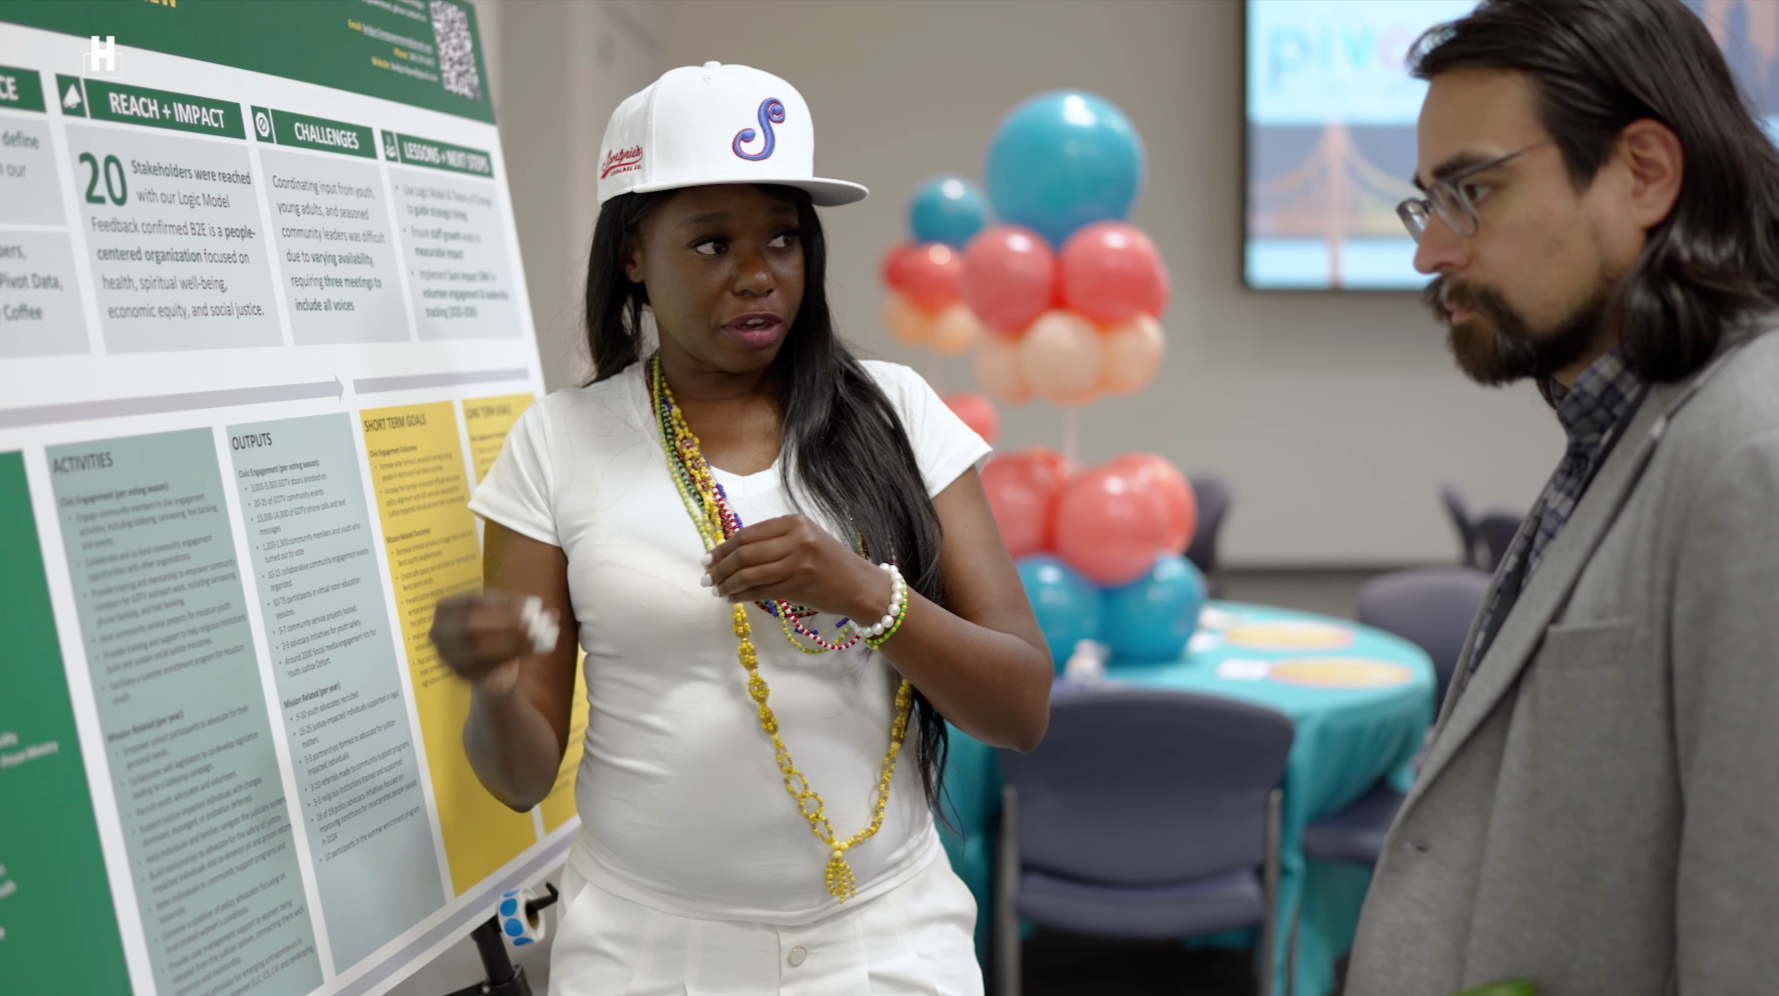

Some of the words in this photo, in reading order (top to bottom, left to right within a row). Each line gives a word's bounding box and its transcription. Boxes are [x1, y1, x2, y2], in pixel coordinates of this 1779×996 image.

[1265, 24, 1412, 97] pivo
[108, 92, 160, 119] REACH
[162, 104, 171, 119] +
[173, 102, 224, 128] IMPACT
[294, 122, 359, 150] CHALLENGES
[732, 97, 785, 161] S
[2, 129, 39, 150] define
[404, 141, 440, 164] LESSONS
[446, 150, 468, 169] NEXT
[467, 155, 490, 173] STEPS
[6, 163, 26, 178] our
[78, 152, 128, 206] 20
[131, 160, 193, 179] Stakeholders
[194, 170, 216, 181] were
[218, 170, 251, 184] reached
[272, 175, 319, 194] Coordinating
[319, 180, 338, 195] input
[338, 182, 354, 195] from
[355, 187, 375, 200] youth,
[136, 188, 158, 202] with
[160, 193, 176, 204] our
[178, 191, 201, 208] Logic
[202, 193, 230, 208] Model
[277, 203, 301, 216] young
[301, 202, 325, 217] adults,
[326, 205, 338, 217] and
[339, 208, 369, 220] seasoned
[91, 216, 139, 233] Feedback
[141, 219, 188, 235] confirmed
[190, 222, 207, 236] B2E
[208, 223, 216, 237] is
[217, 227, 223, 237] a
[224, 225, 256, 241] people-
[282, 227, 322, 241] community
[322, 227, 347, 241] leaders
[348, 232, 361, 242] was
[362, 230, 385, 243] difficult
[97, 246, 142, 261] centered
[144, 248, 202, 264] organization
[204, 248, 237, 264] focused
[239, 254, 250, 264] on
[286, 249, 301, 262] due
[301, 251, 310, 262] to
[311, 251, 338, 266] varying
[338, 252, 375, 267] availability,
[31, 271, 64, 292] Data,
[102, 274, 138, 292] health,
[139, 275, 178, 292] spiritual
[179, 276, 228, 292] well-being,
[291, 274, 324, 289] requiring
[324, 274, 343, 287] three
[344, 276, 374, 290] meetings
[374, 278, 382, 288] to
[3, 302, 43, 321] Coffee
[108, 303, 156, 319] economic
[158, 303, 190, 320] equity,
[192, 302, 208, 316] and
[210, 302, 234, 316] social
[235, 302, 264, 318] justice.
[295, 298, 322, 310] include
[323, 298, 332, 310] all
[333, 299, 354, 310] voices
[364, 418, 386, 432] SHORT
[387, 416, 406, 429] TERM
[406, 413, 426, 426] GOALS
[232, 432, 272, 450] OUTPUTS
[53, 452, 113, 474] ACTIVITIES
[238, 470, 250, 478] Civic
[250, 466, 278, 477] Engagement
[279, 464, 288, 473] (per
[302, 459, 320, 468] season):
[284, 698, 302, 708] Mission
[302, 689, 319, 702] Related
[319, 688, 328, 697] (per
[328, 682, 341, 693] year):
